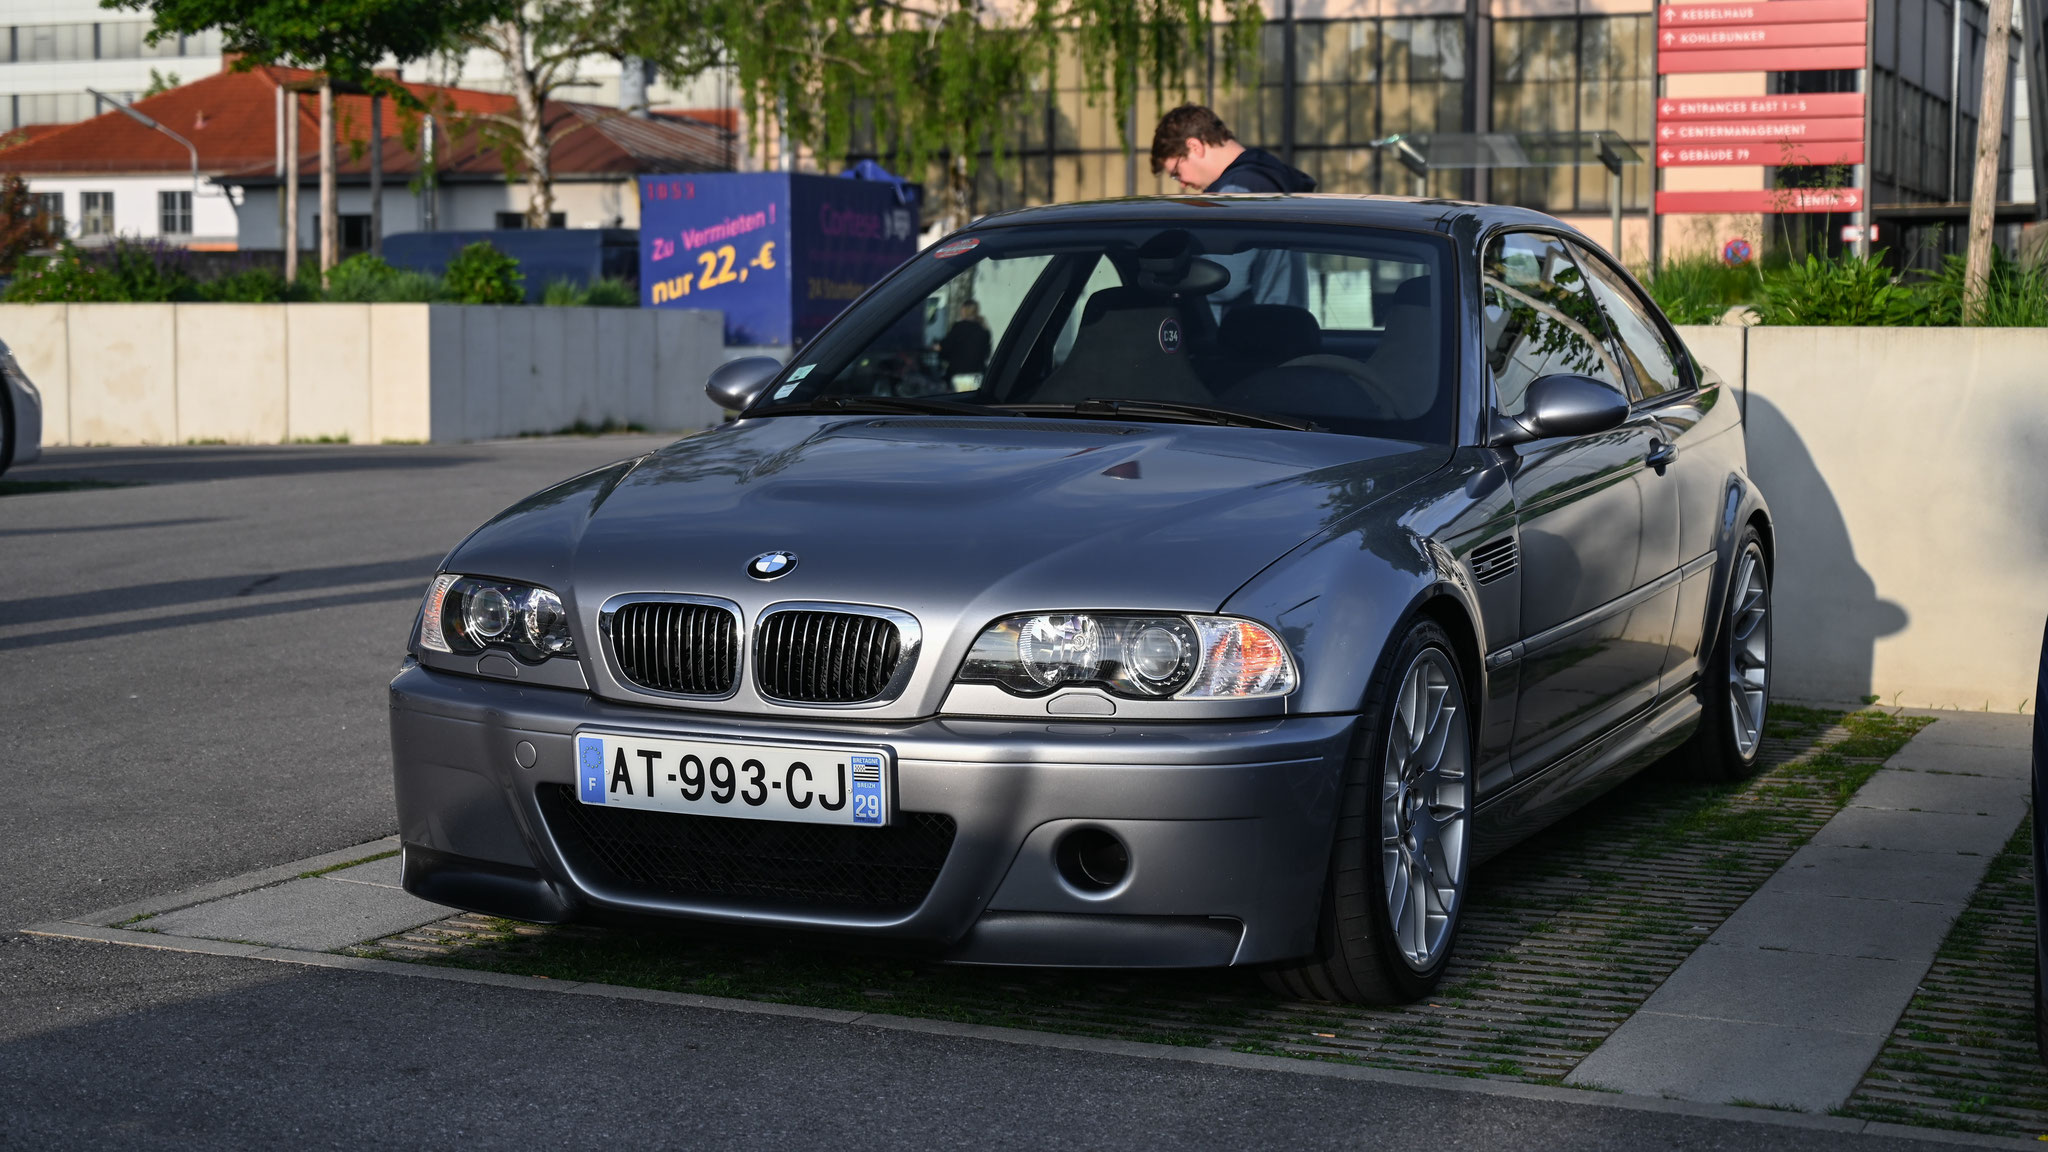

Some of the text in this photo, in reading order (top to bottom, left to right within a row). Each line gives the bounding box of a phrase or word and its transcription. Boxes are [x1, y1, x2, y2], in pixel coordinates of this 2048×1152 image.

[1682, 8, 1754, 20] KESSELHAUS
[1680, 31, 1766, 43] KOHLEBUNKER
[1680, 103, 1747, 115] ENTRANCES
[1752, 101, 1778, 112] EAST
[1680, 125, 1806, 137] CENTERMANAGEMENT
[1680, 148, 1750, 161] GEBÄUDE 79
[652, 238, 674, 261] Zu
[681, 211, 766, 250] Vermieten
[652, 273, 694, 304] nur
[853, 757, 878, 765] BRETAGNE
[588, 777, 597, 791] F
[610, 747, 847, 811] AT-993-CJ
[855, 794, 879, 818] 29
